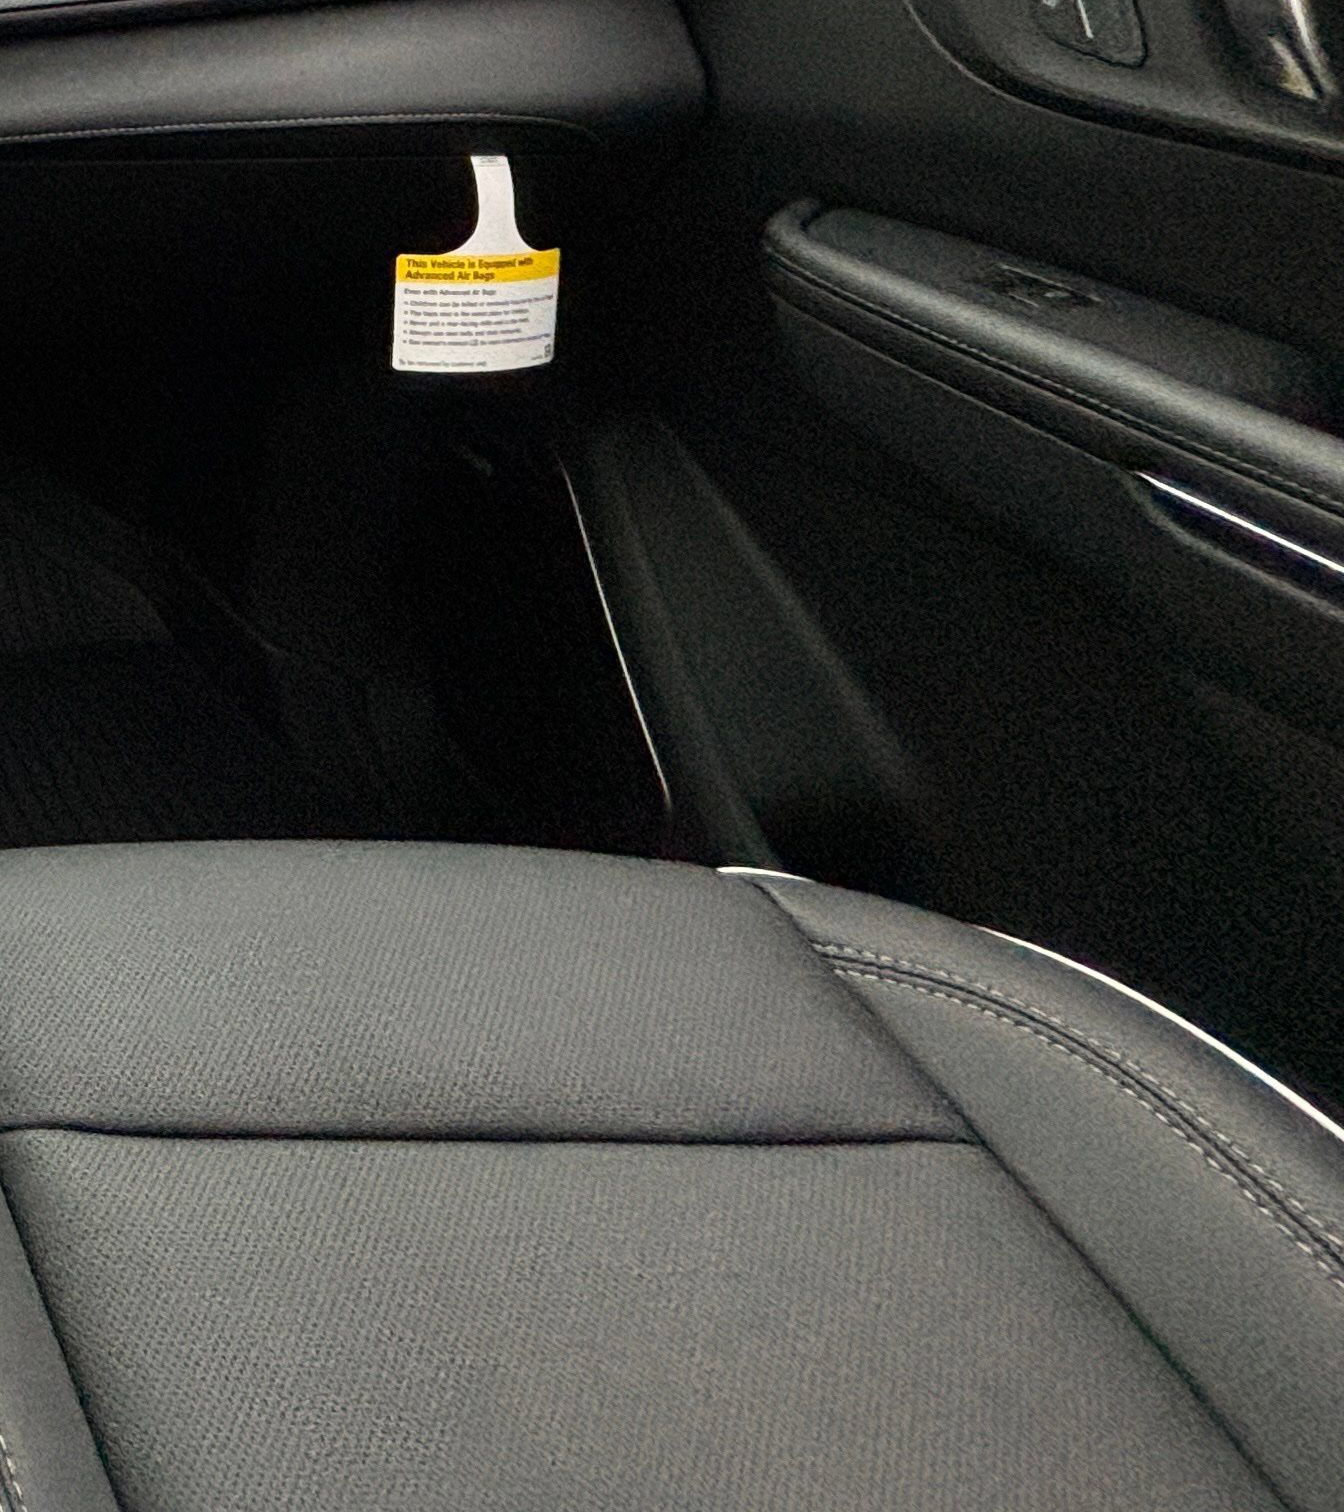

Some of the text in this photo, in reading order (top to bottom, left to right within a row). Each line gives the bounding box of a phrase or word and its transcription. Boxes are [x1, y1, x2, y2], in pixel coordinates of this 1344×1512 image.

[406, 258, 427, 269] This
[430, 259, 465, 269] Vehicle
[405, 270, 495, 282] Advanced Air Bags
